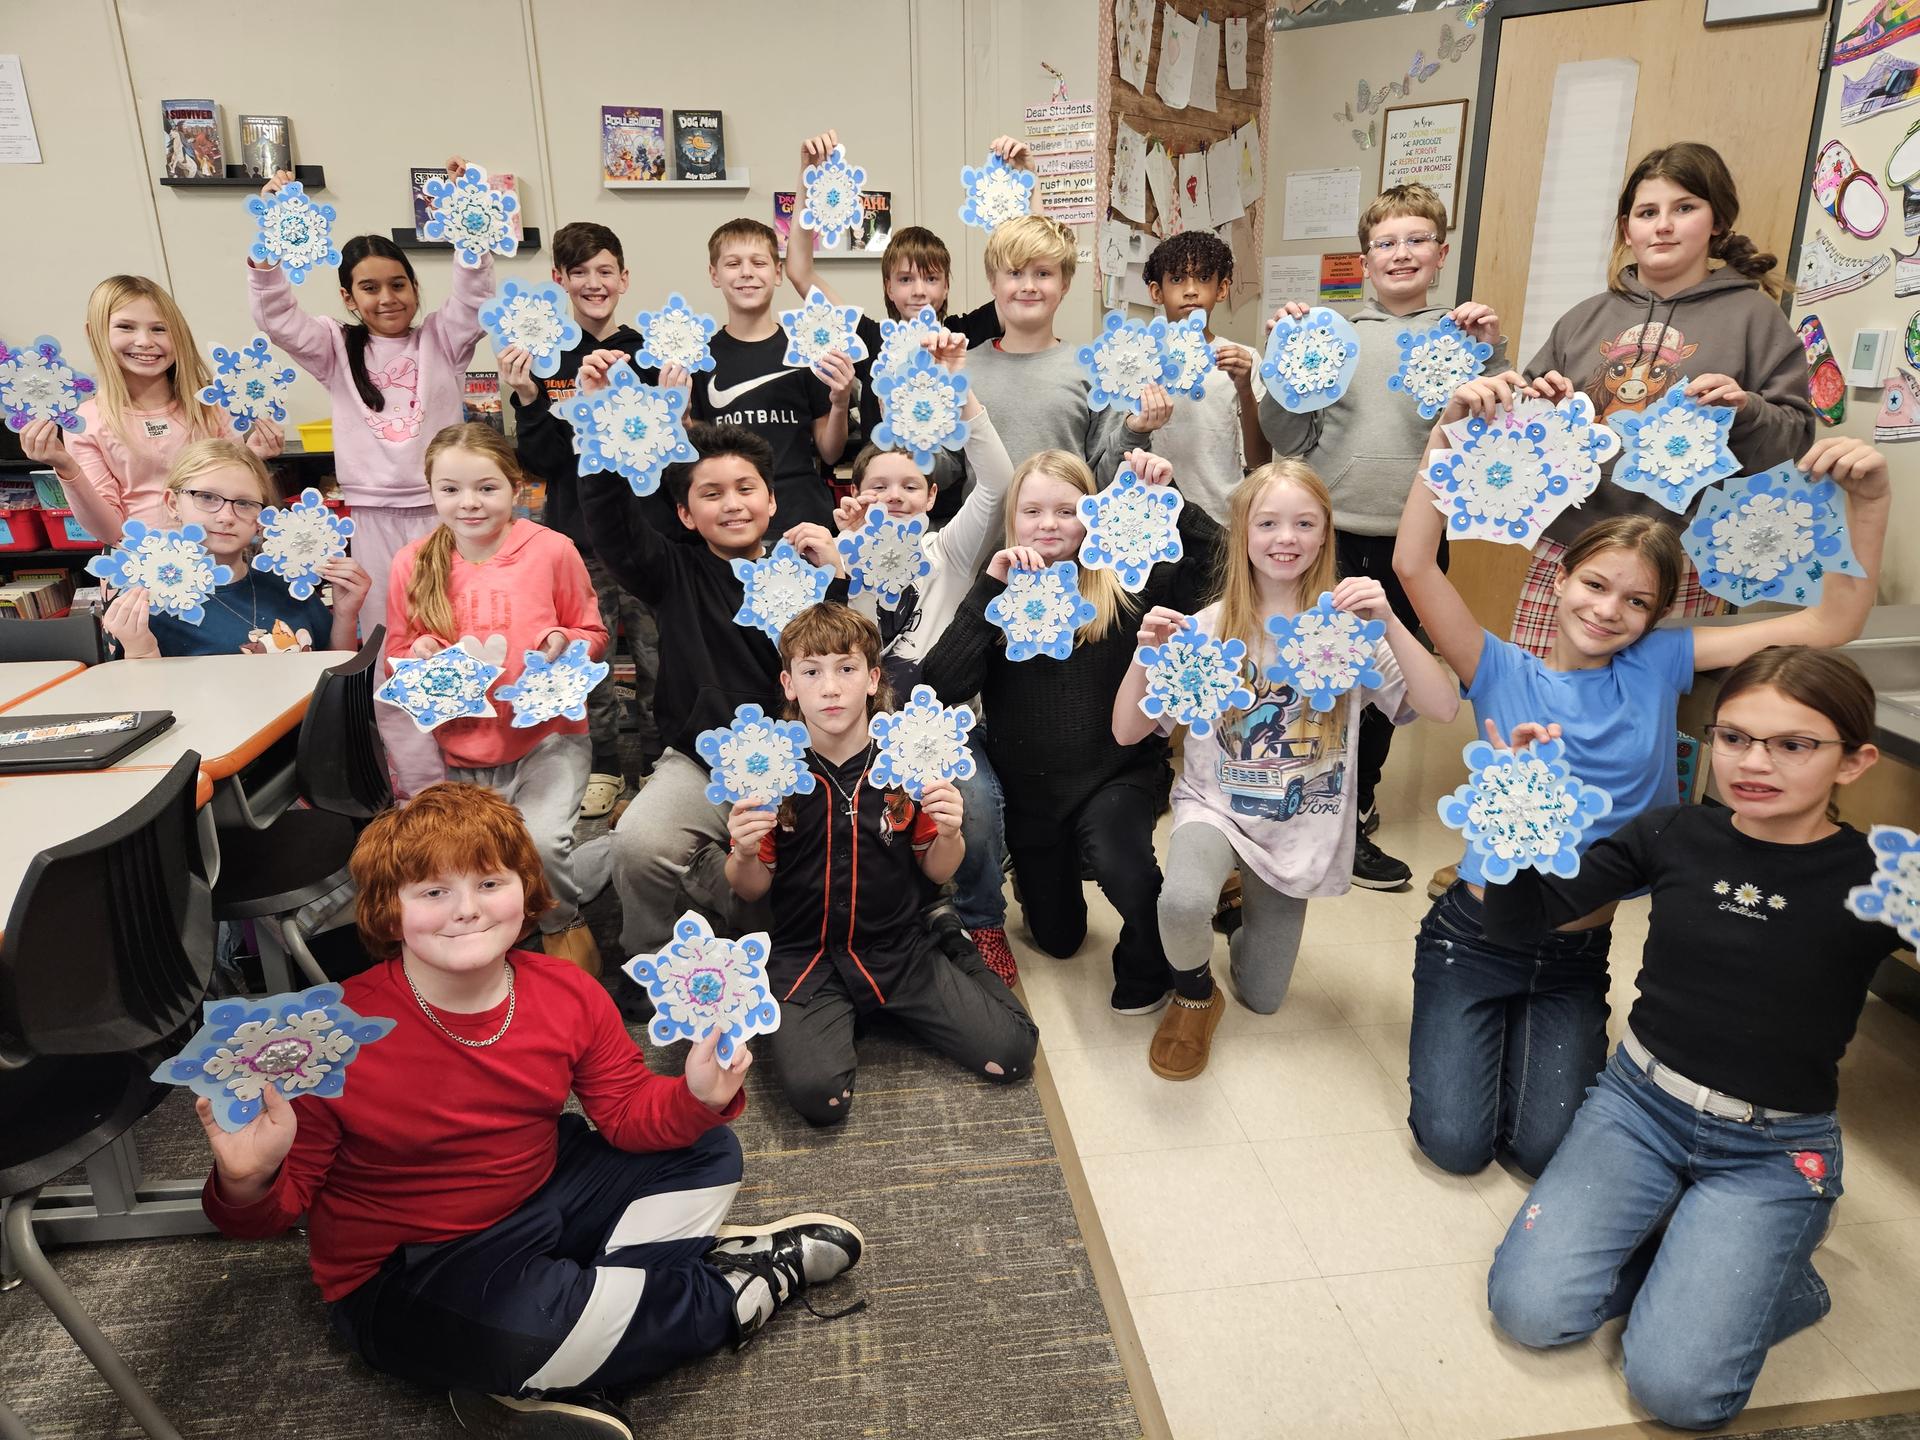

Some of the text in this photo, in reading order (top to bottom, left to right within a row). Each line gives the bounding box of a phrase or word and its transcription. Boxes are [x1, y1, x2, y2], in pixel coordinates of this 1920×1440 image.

[171, 110, 213, 119] SURVIVED
[1026, 108, 1047, 119] Dear
[679, 116, 718, 129] DOG MAN
[1027, 125, 1041, 135] You
[1081, 121, 1094, 129] for
[1030, 141, 1062, 151] believe
[1412, 137, 1441, 146] APOLOGIZE
[1415, 147, 1437, 155] FORGIVE
[1398, 157, 1419, 166] RESPECT
[1423, 163, 1452, 172] PROMISES
[1040, 179, 1060, 190] rust
[1063, 178, 1071, 187] in
[1863, 344, 1870, 352] 72
[716, 410, 799, 427] FOOTBALL
[1297, 793, 1341, 815] Ford
[1718, 901, 1769, 921] Hollister
